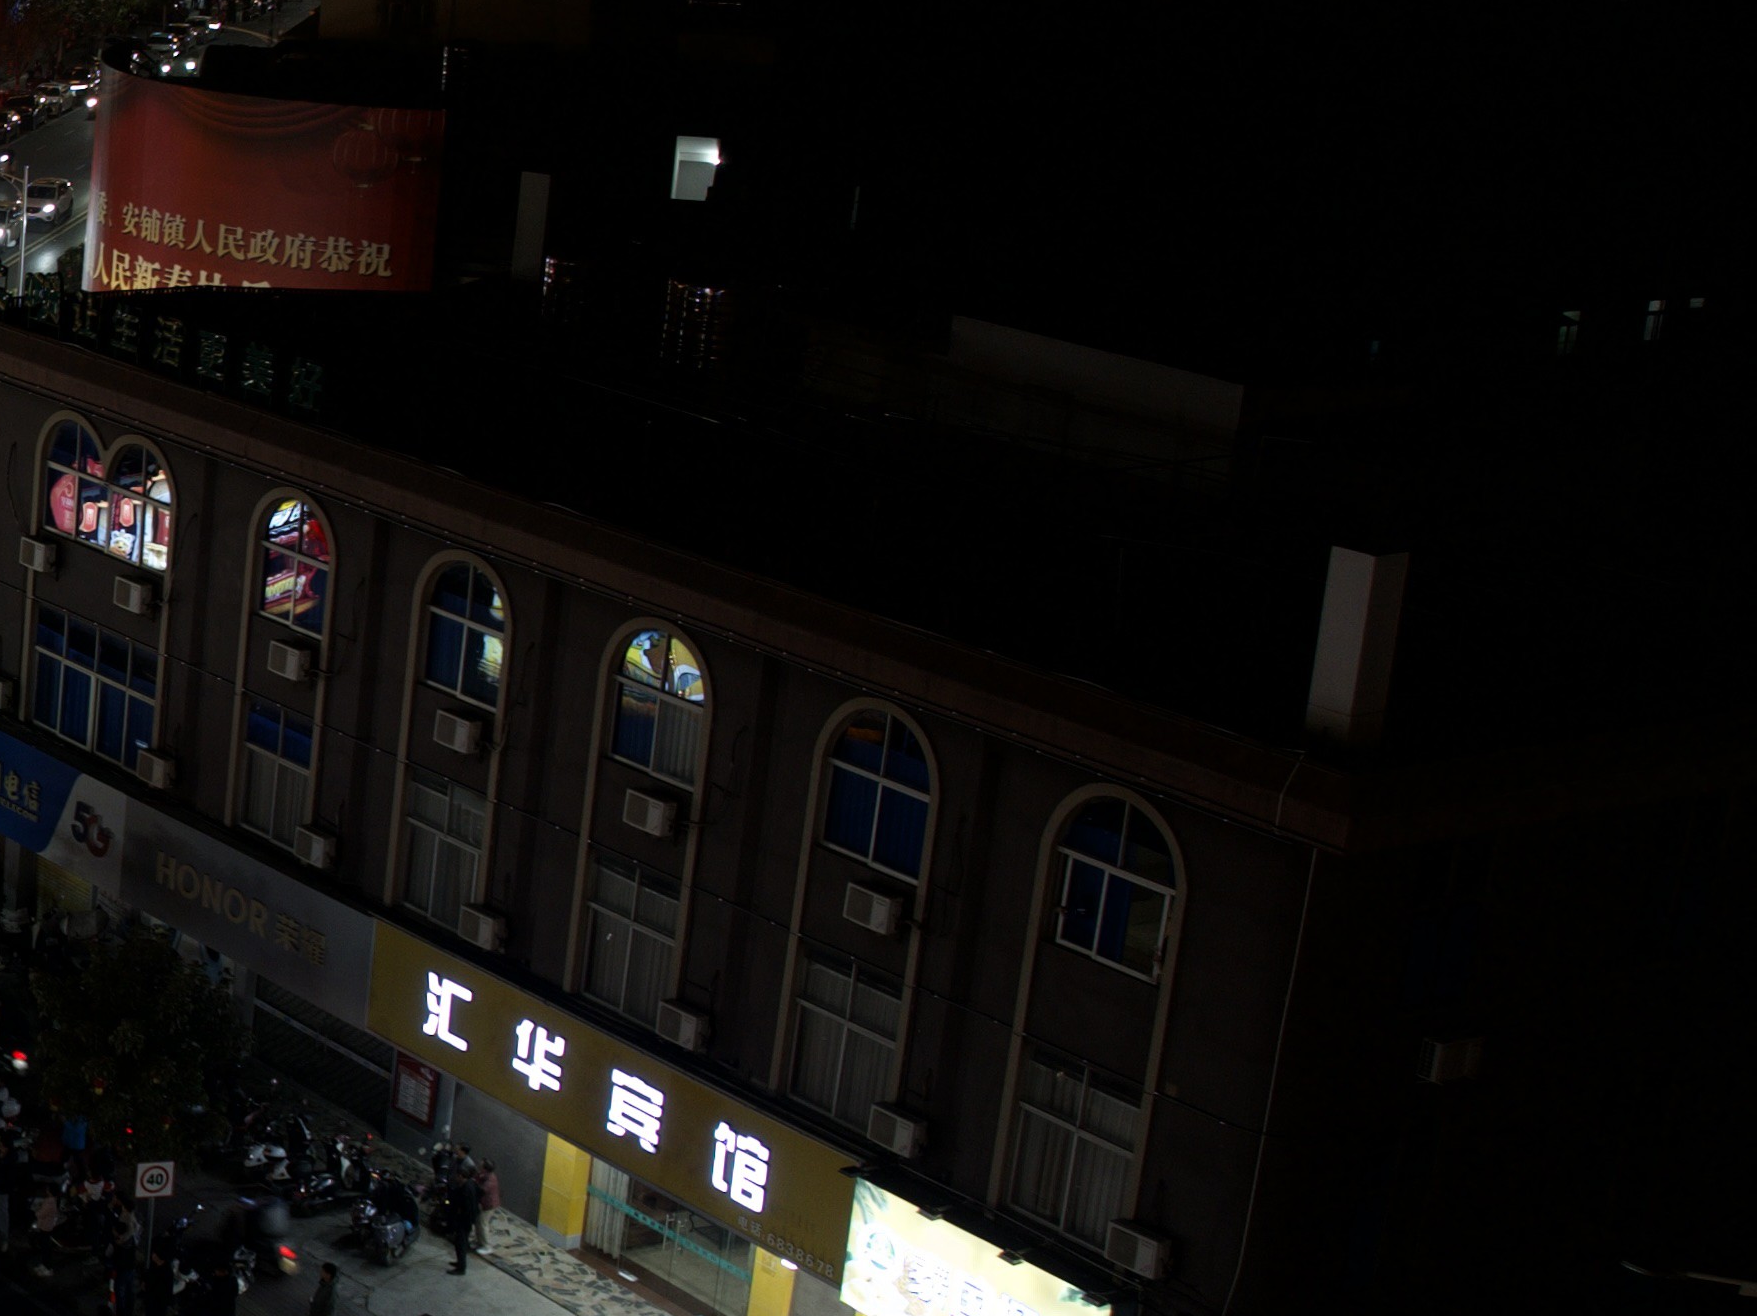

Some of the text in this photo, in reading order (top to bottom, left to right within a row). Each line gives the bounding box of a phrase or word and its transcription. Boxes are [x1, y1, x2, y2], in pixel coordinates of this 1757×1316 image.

[71, 800, 115, 858] 5G
[156, 848, 268, 939] HONOR
[421, 970, 771, 1215] 汇华宾馆
[145, 1173, 164, 1186] 40
